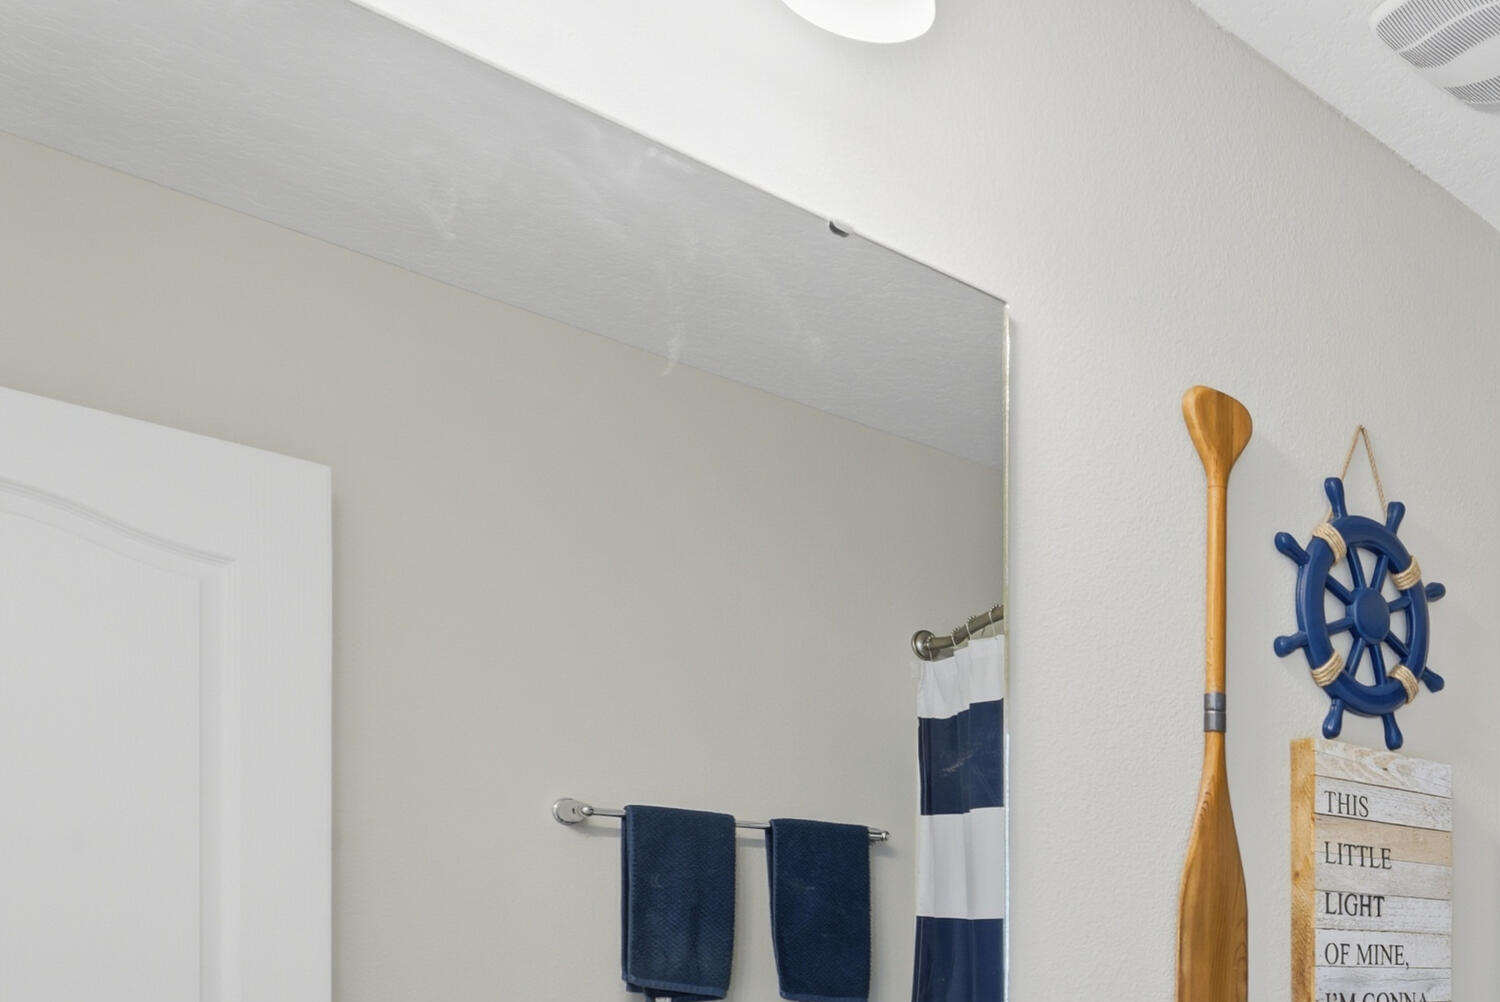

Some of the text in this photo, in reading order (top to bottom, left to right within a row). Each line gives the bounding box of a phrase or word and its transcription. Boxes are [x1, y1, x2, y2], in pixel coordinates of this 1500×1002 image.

[1324, 790, 1369, 818] THIS
[1324, 841, 1392, 870] LITTLE
[1324, 892, 1385, 917] LIGHT
[1325, 943, 1409, 969] OF MINE,
